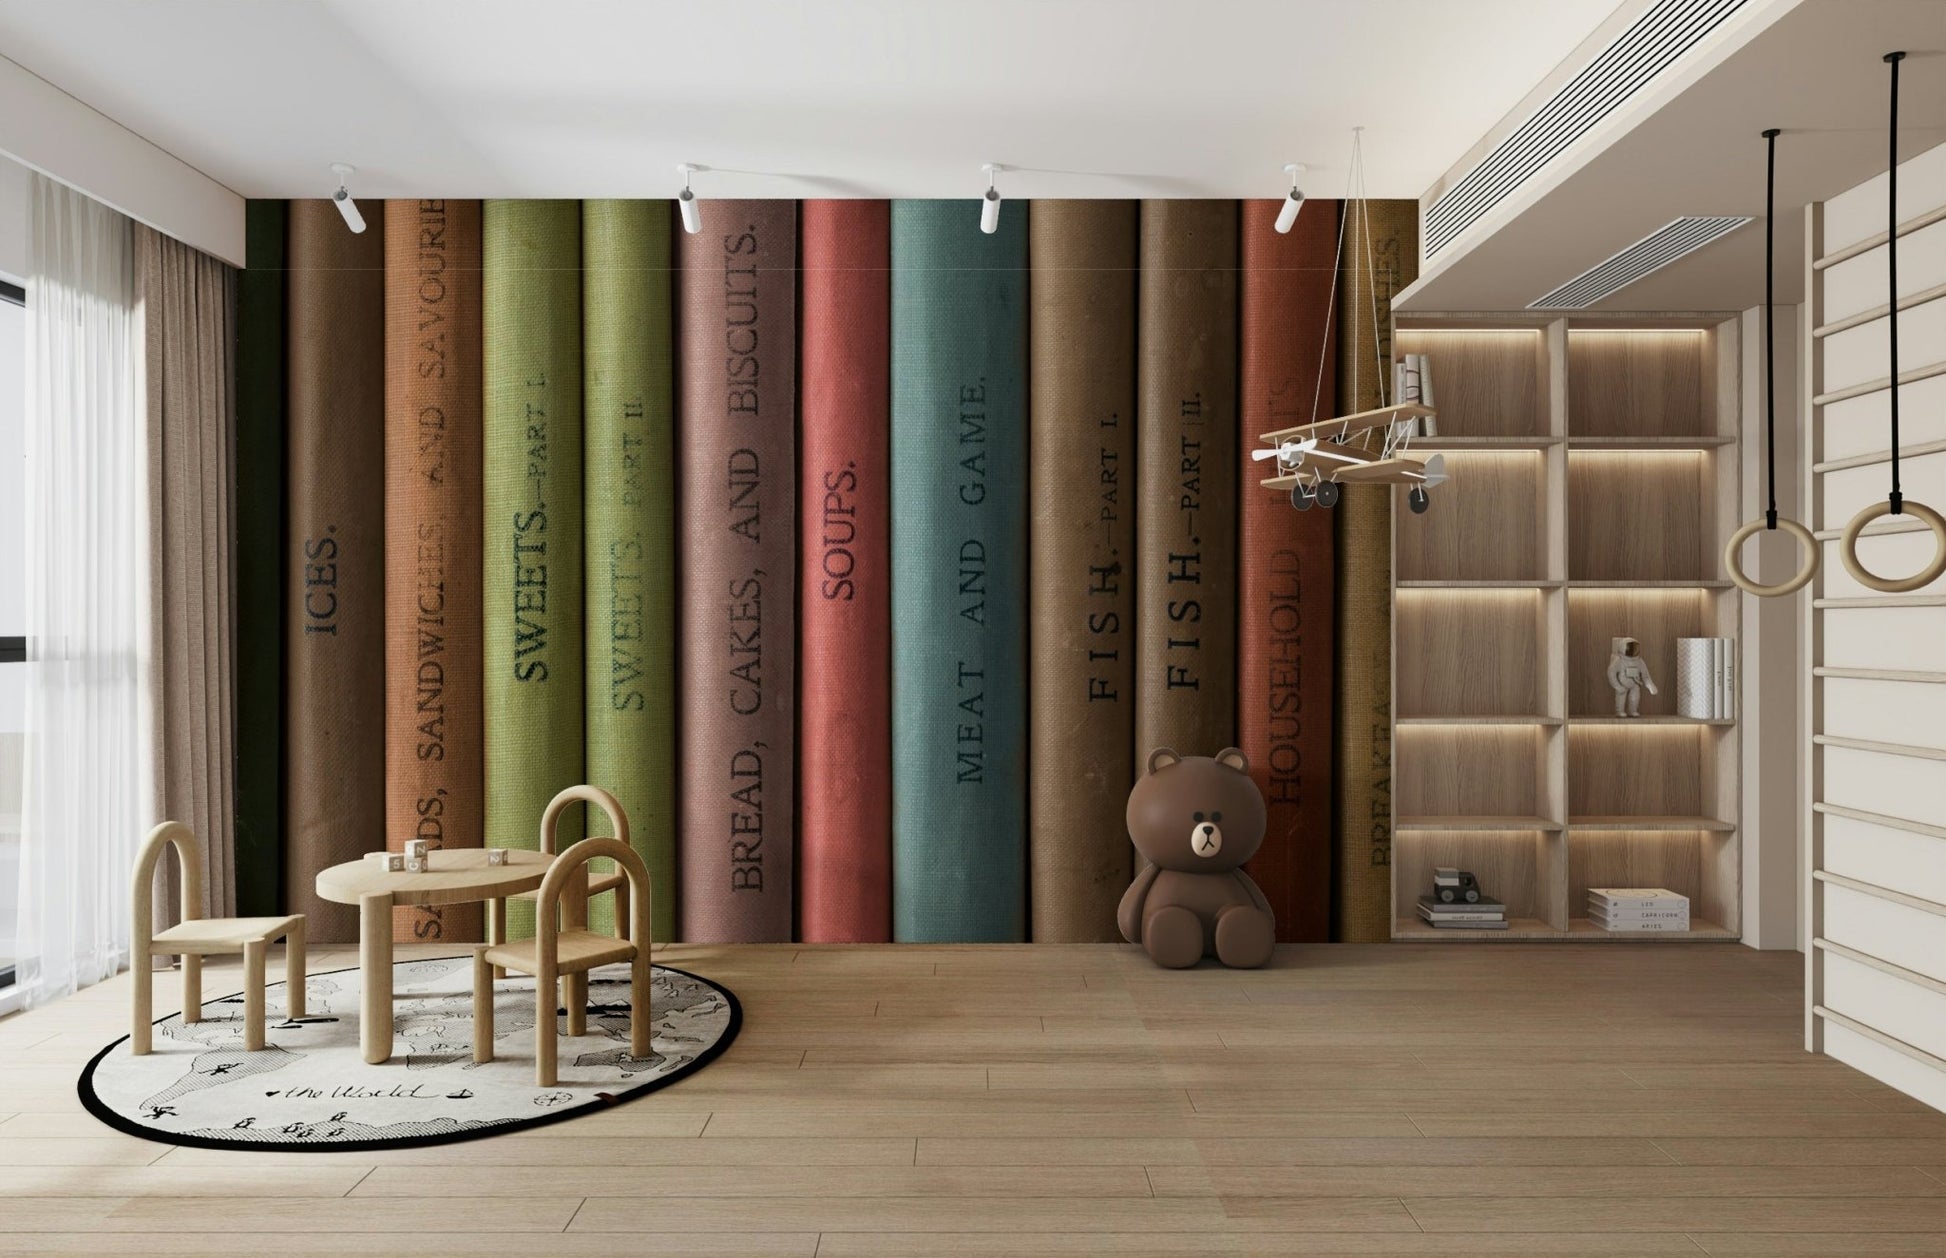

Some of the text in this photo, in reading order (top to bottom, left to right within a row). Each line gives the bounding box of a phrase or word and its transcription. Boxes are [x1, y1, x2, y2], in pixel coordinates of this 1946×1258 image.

[418, 407, 445, 488] AND
[622, 431, 644, 509] PART
[303, 524, 338, 637] ICES.
[724, 223, 768, 893] BREAD, CAKES, AND BISCUITS.
[821, 460, 858, 602] SOUPS.
[956, 376, 987, 785] MEAT AND GAME.
[611, 532, 646, 711] SWEETS.
[1267, 549, 1302, 806] HOUSEHOLD
